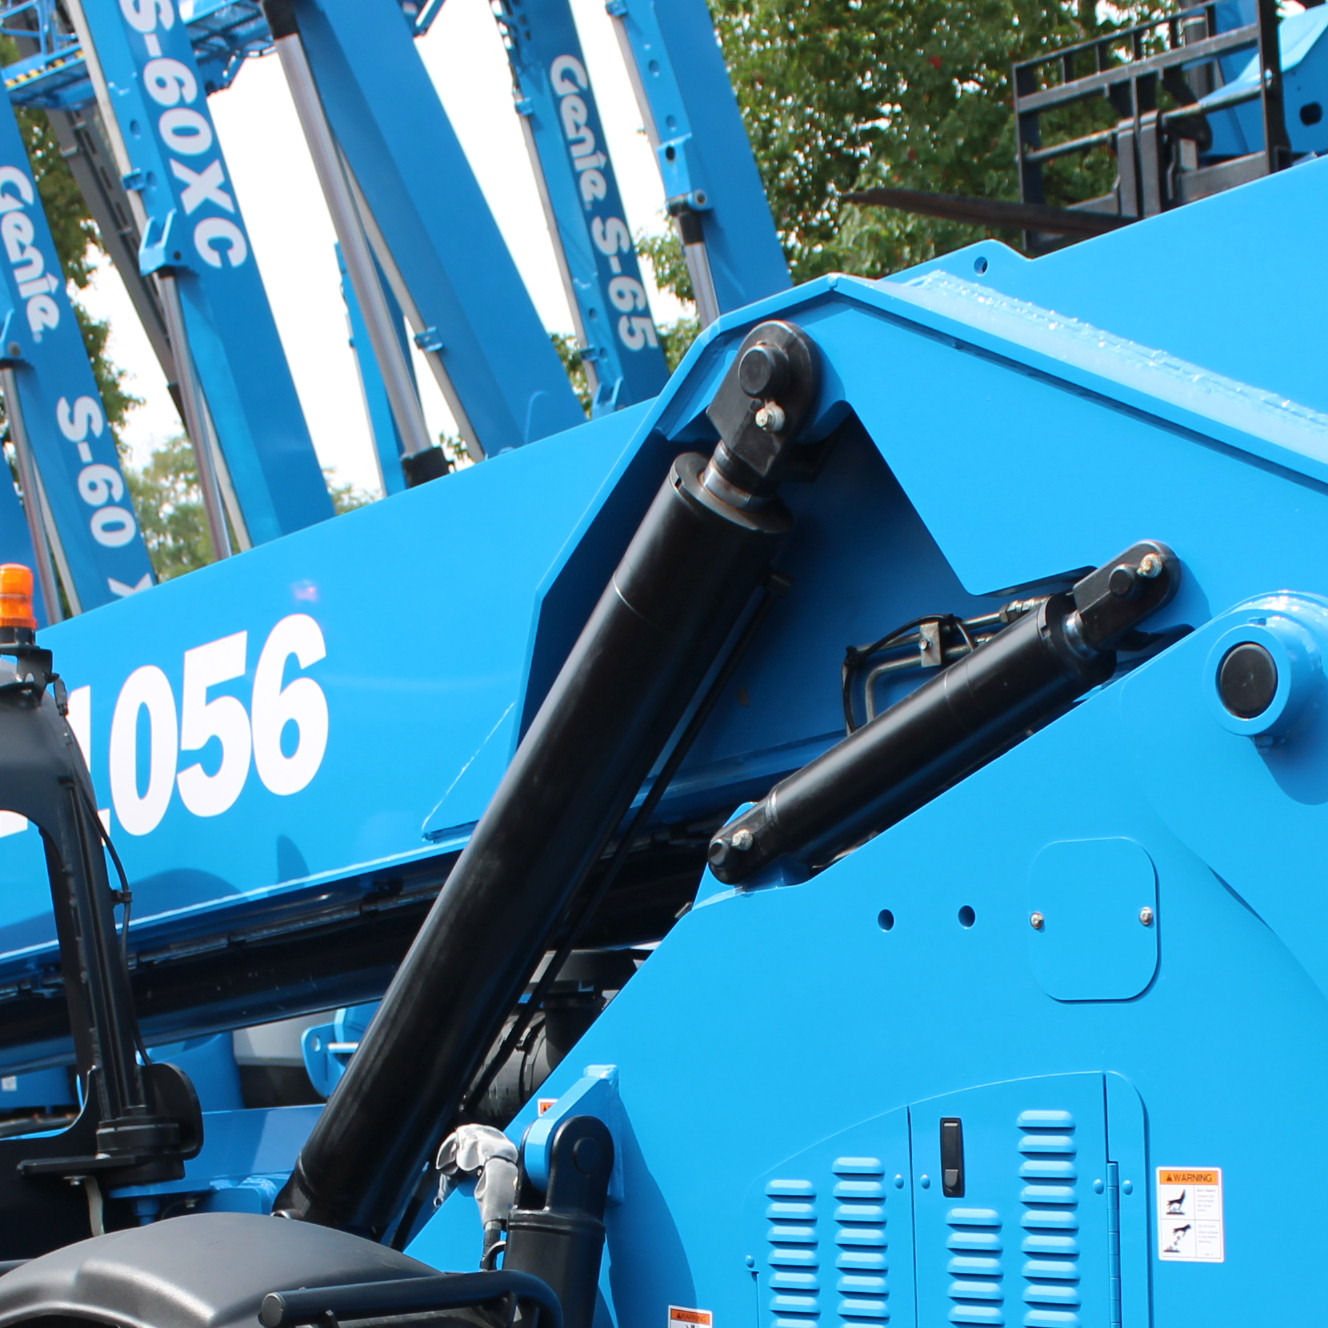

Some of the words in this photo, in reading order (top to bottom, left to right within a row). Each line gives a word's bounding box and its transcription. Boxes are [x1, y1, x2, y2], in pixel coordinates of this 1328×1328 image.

[122, 0, 248, 270] S-60XC
[549, 54, 607, 206] Genie
[591, 215, 659, 351] S-65
[56, 396, 137, 548] S-60
[1173, 1173, 1213, 1183] WARNING
